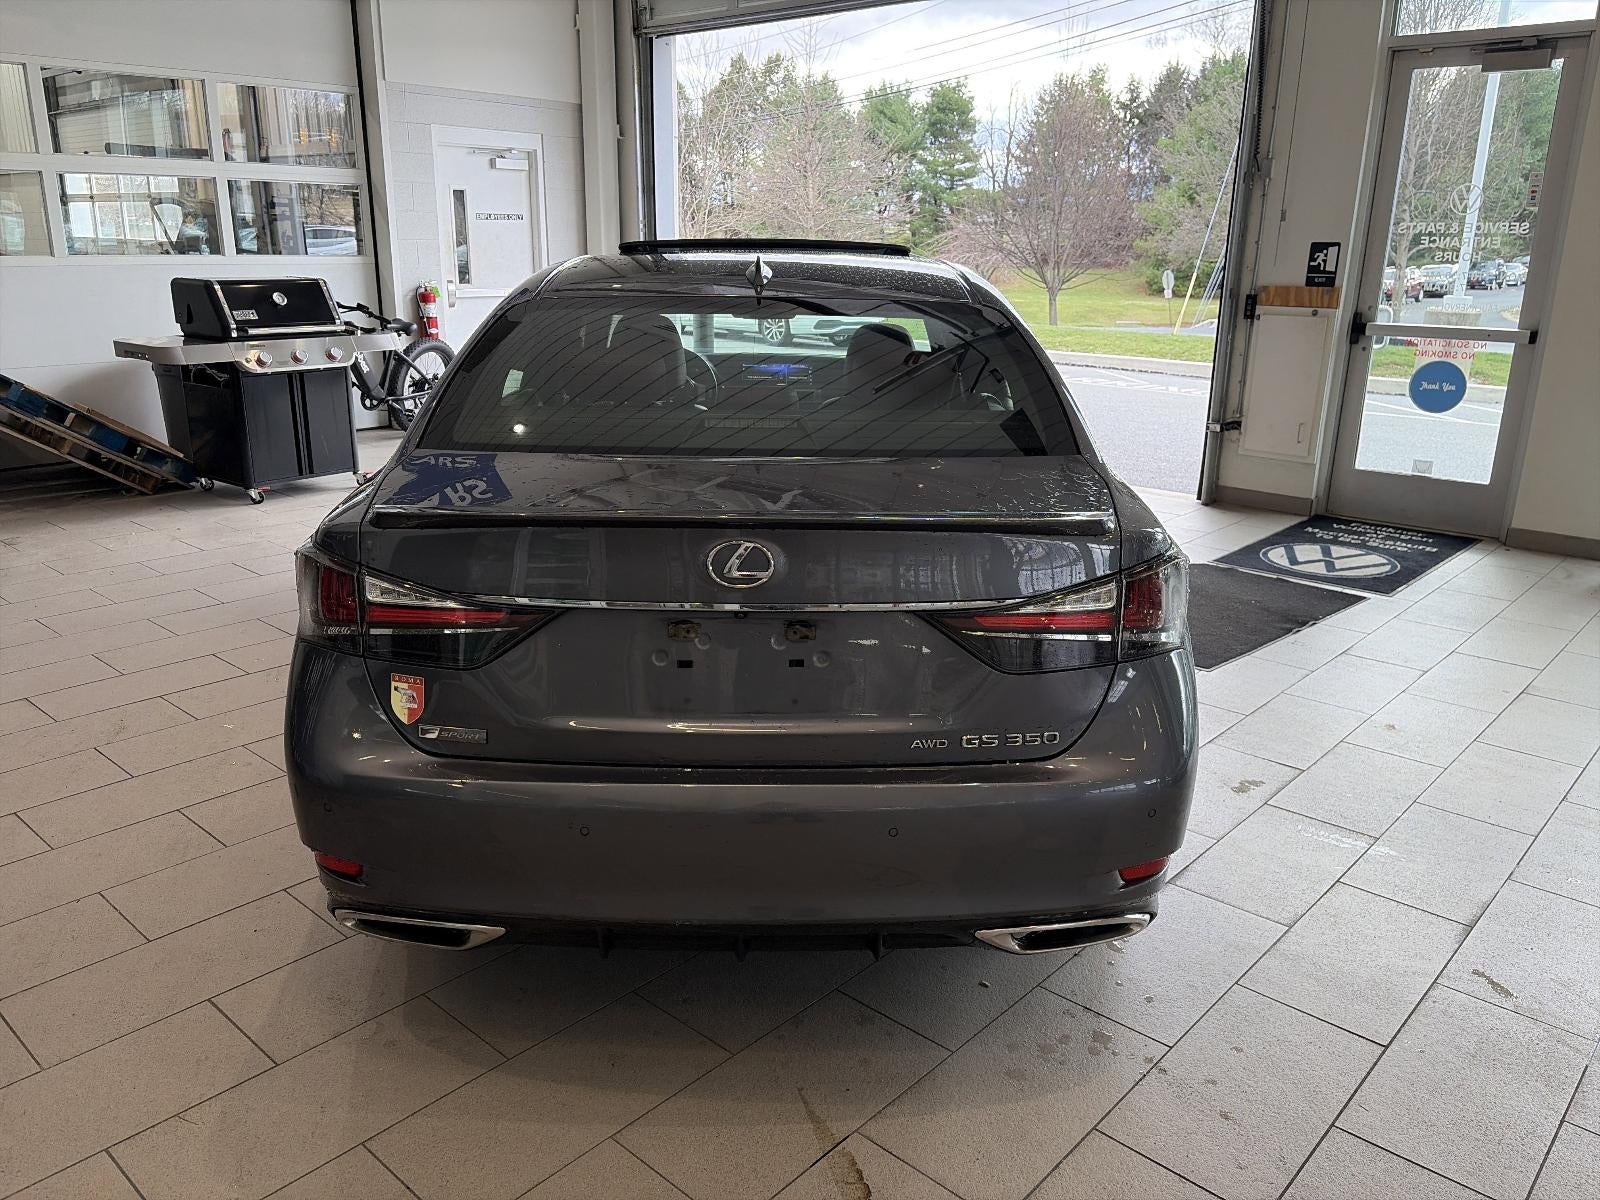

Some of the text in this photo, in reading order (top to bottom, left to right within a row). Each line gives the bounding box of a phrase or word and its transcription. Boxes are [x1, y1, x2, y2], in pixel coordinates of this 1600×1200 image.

[1419, 381, 1456, 392] Thank You
[394, 675, 421, 684] ROMA
[440, 730, 481, 740] SPORT
[911, 732, 1060, 749] AWD GS 350
